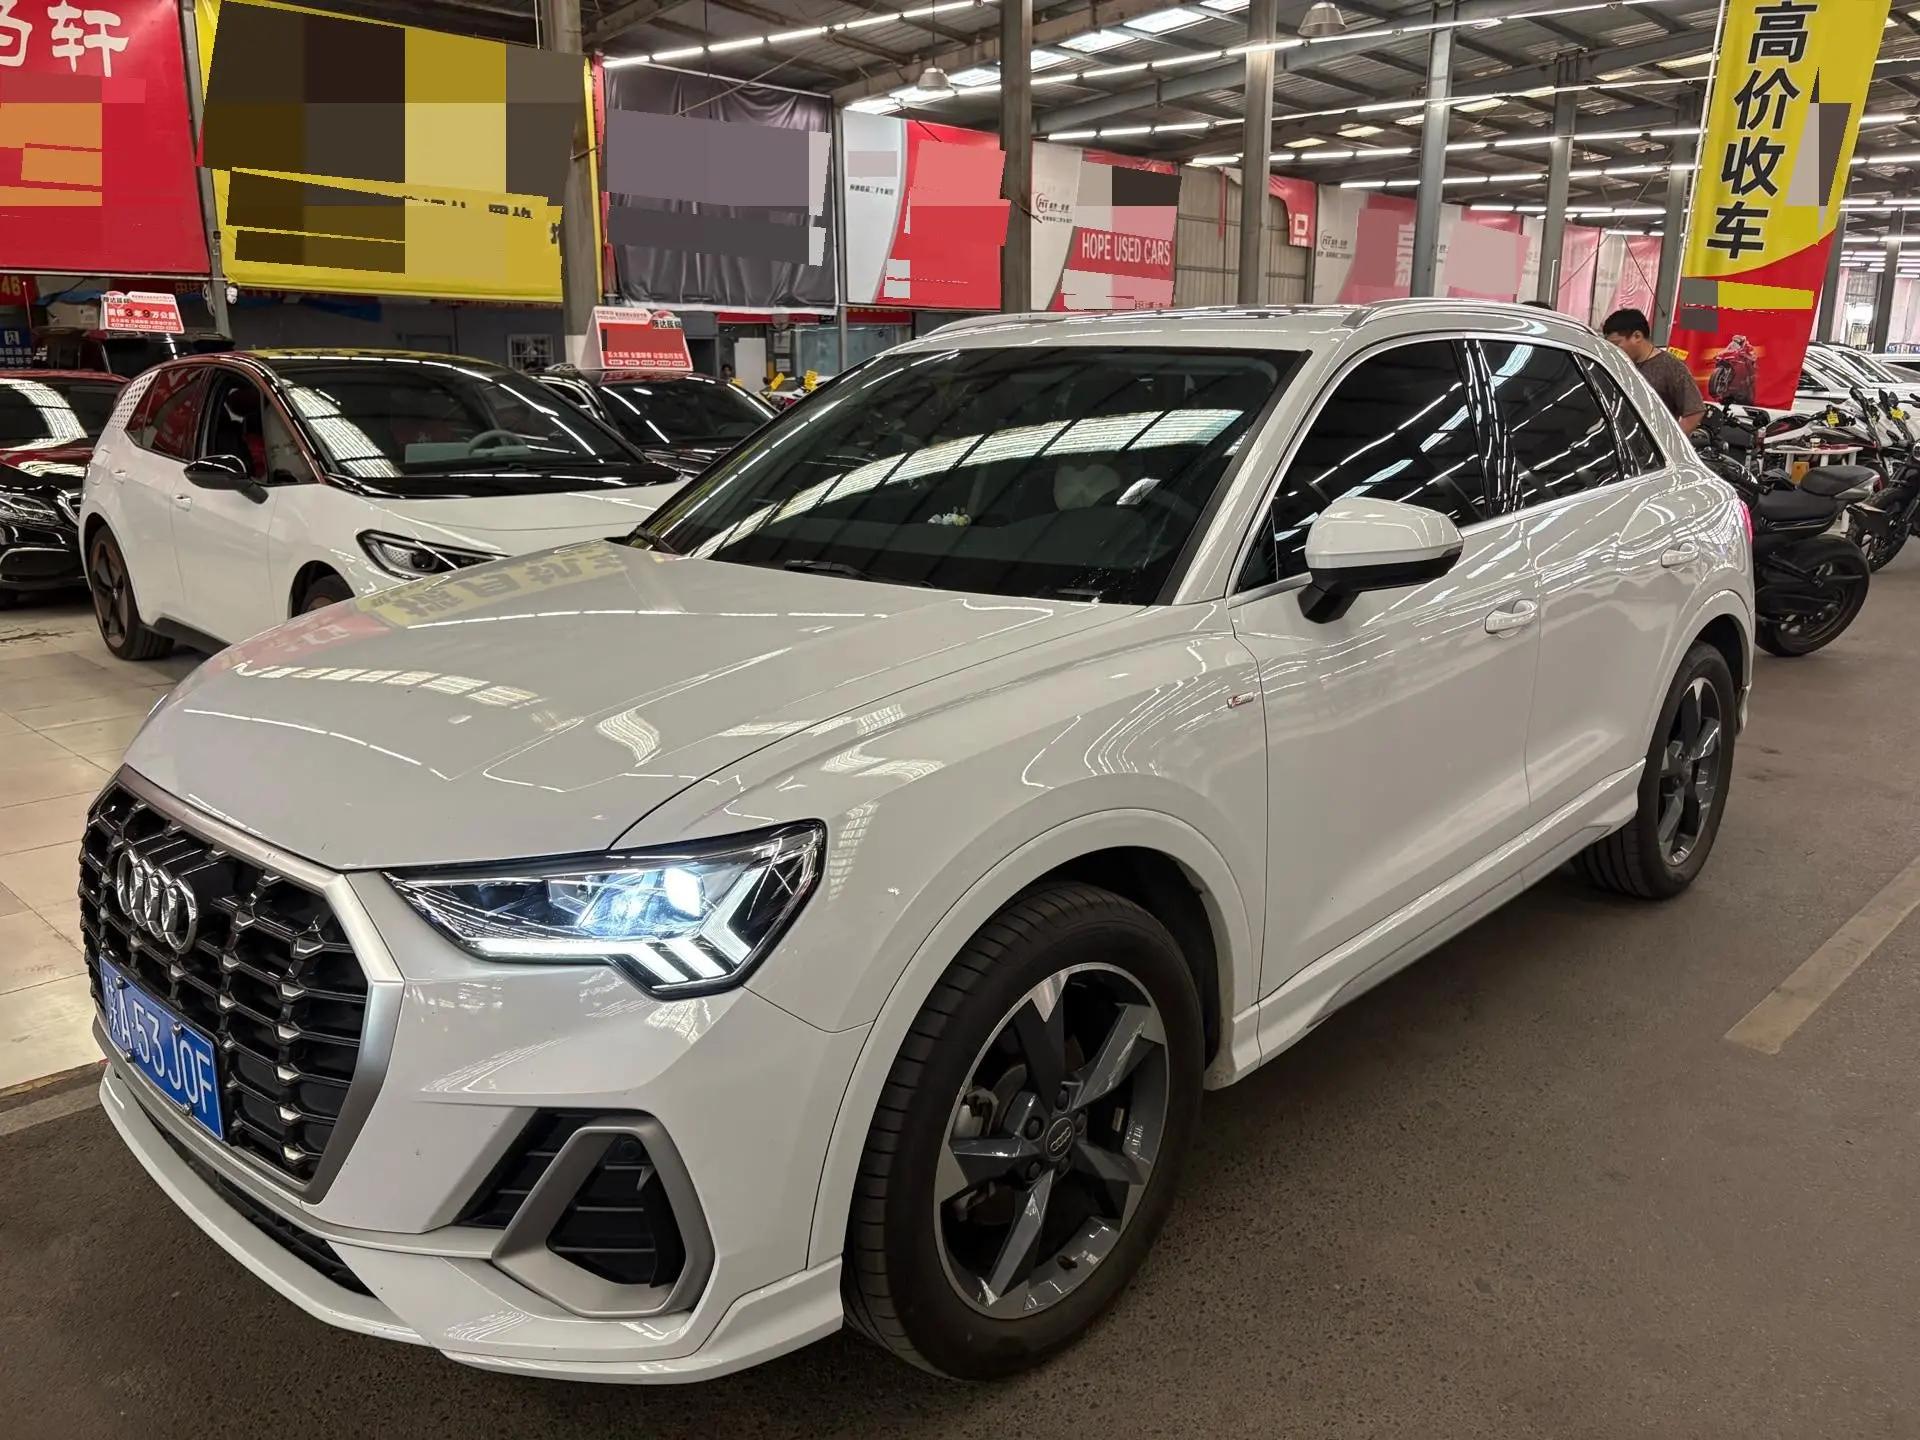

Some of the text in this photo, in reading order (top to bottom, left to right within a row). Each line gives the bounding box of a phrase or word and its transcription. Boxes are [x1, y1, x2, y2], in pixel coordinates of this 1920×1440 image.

[1706, 0, 1818, 259] 高价收车
[1081, 232, 1171, 266] HOPE USED CARS
